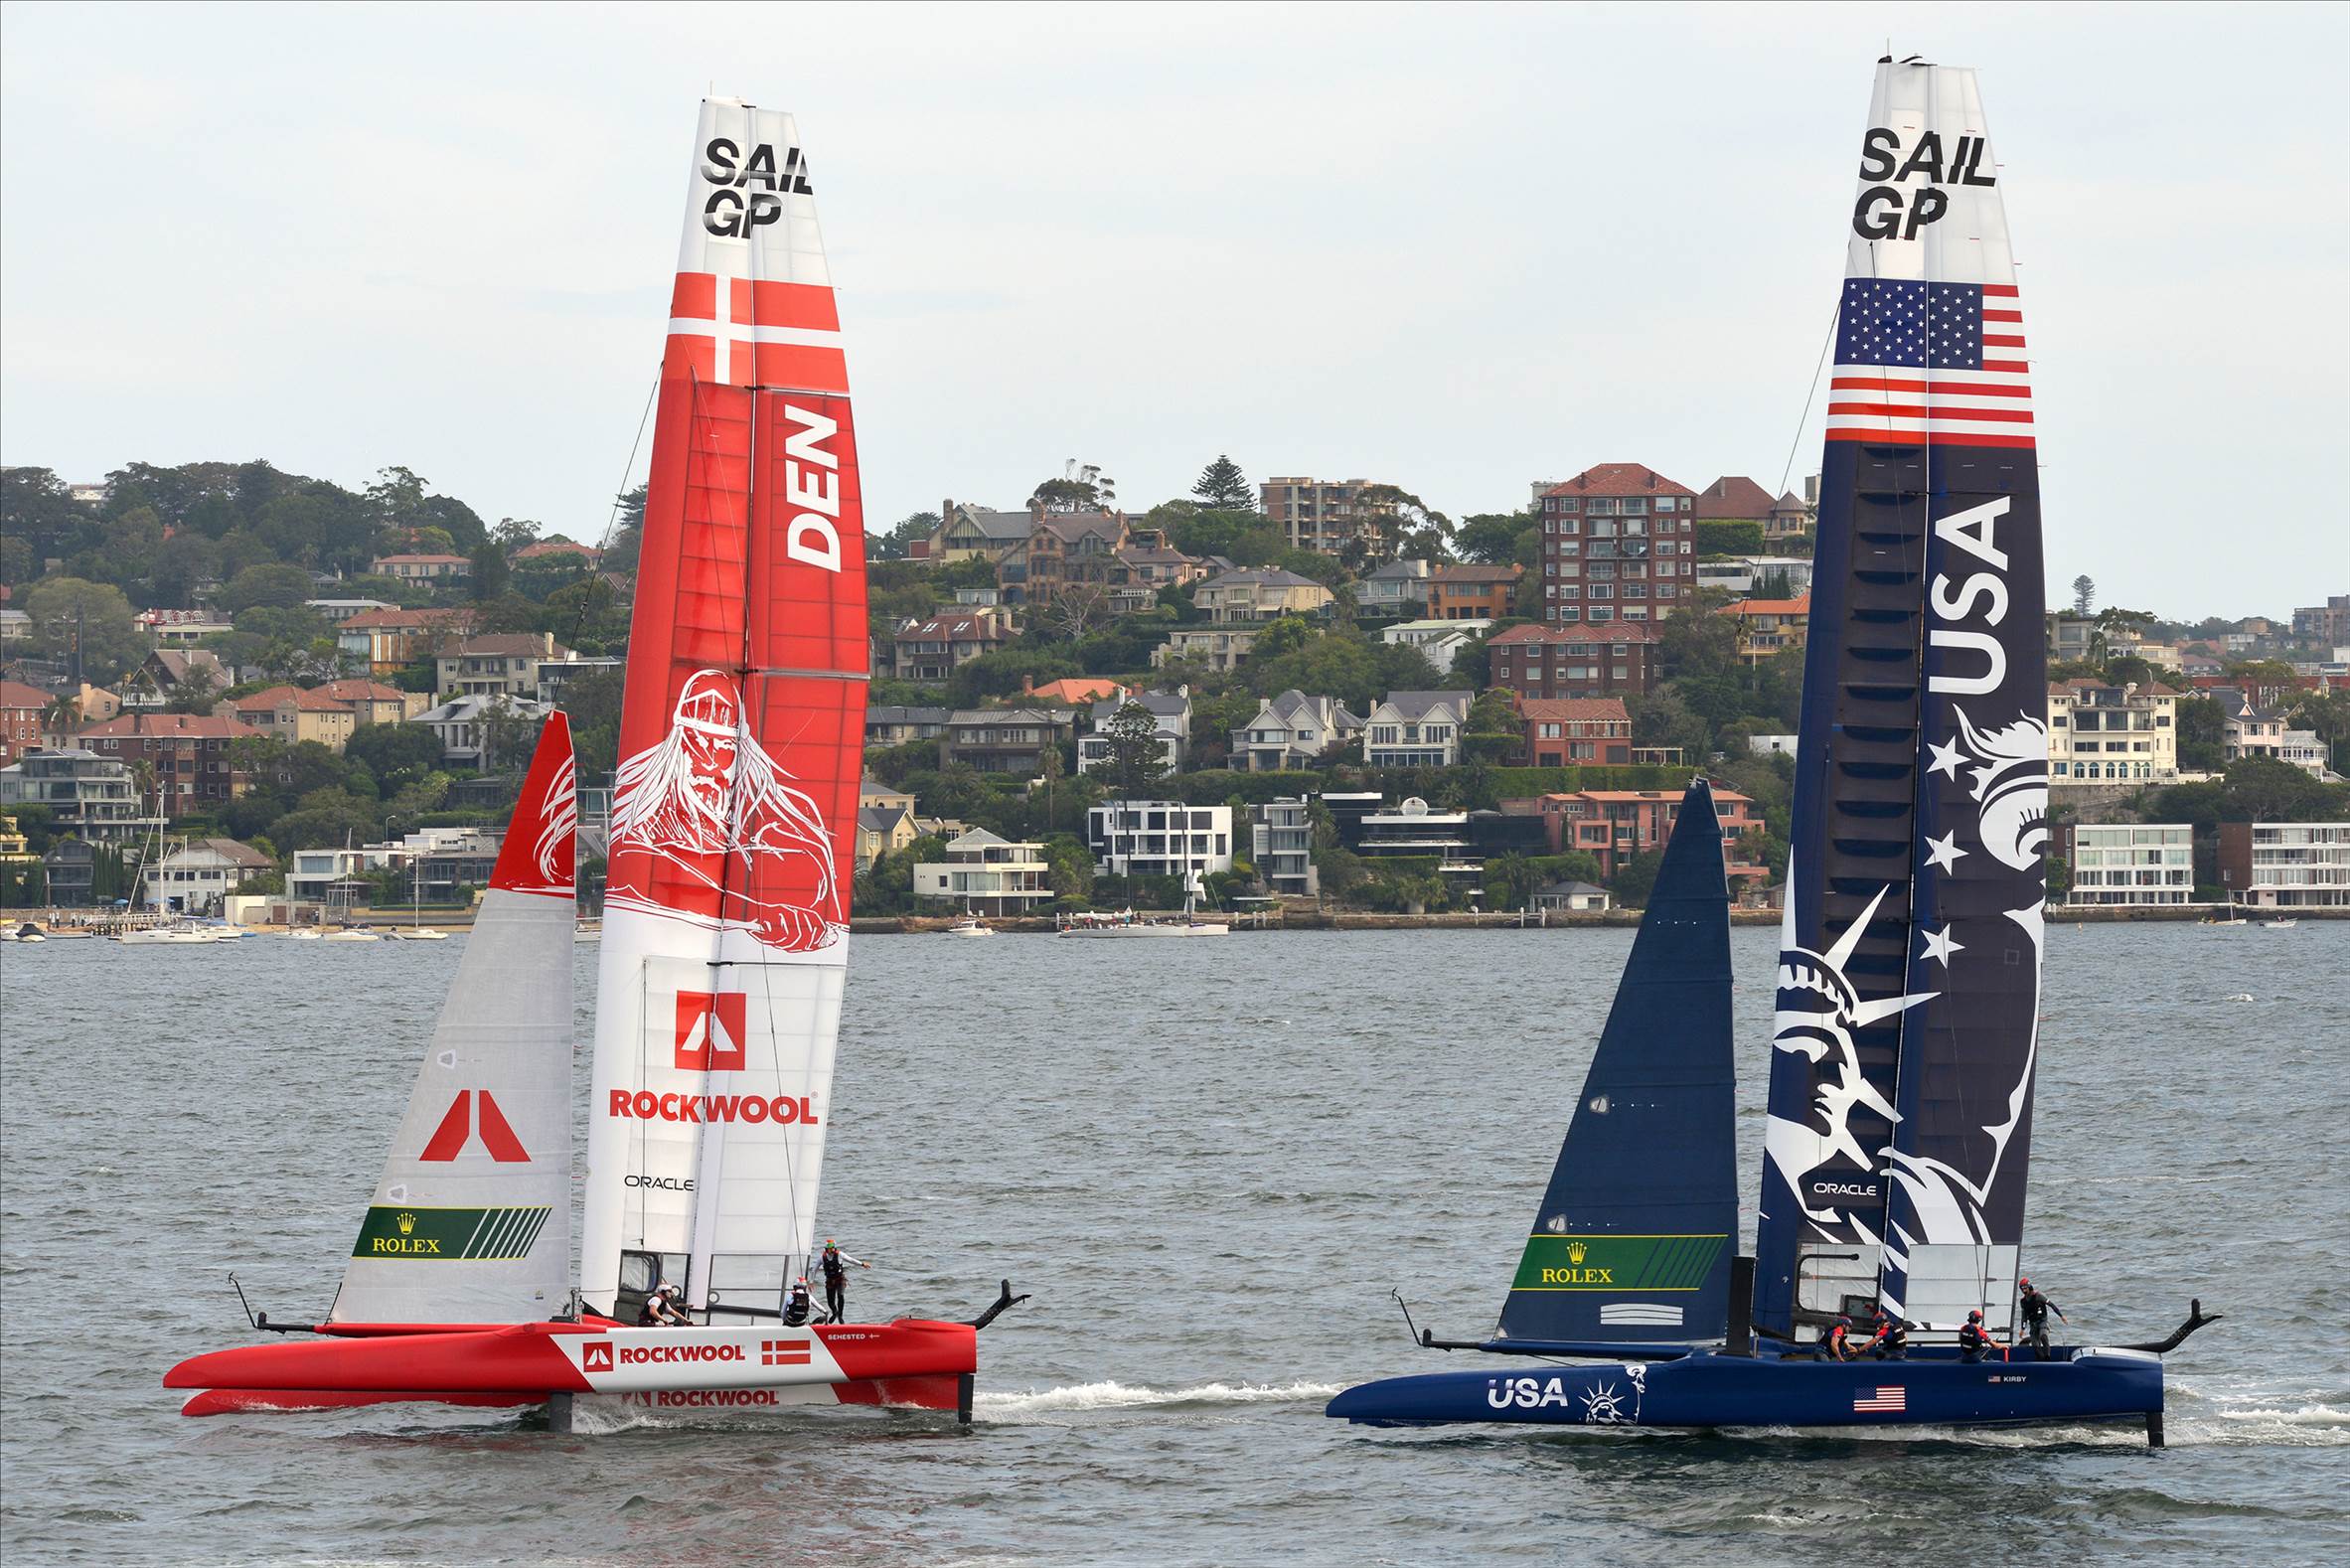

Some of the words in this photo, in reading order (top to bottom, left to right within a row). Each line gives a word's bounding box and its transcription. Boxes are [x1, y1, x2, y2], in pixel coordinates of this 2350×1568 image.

[701, 137, 813, 195] SAIL
[1859, 127, 1996, 187] SAIL
[702, 189, 783, 239] GP
[1852, 186, 1949, 240] GP
[785, 403, 842, 572] DEN
[1929, 496, 2011, 696] USA
[609, 1089, 819, 1125] ROCKWOOL
[624, 1175, 695, 1191] ORACLE
[1813, 1182, 1877, 1196] ORACLE
[373, 1238, 440, 1254] ROLEX
[1541, 1268, 1613, 1284] ROLEX
[620, 1344, 745, 1364] ROCKWOOL
[657, 1389, 780, 1407] ROCKWOOL
[1488, 1377, 1568, 1409] USA
